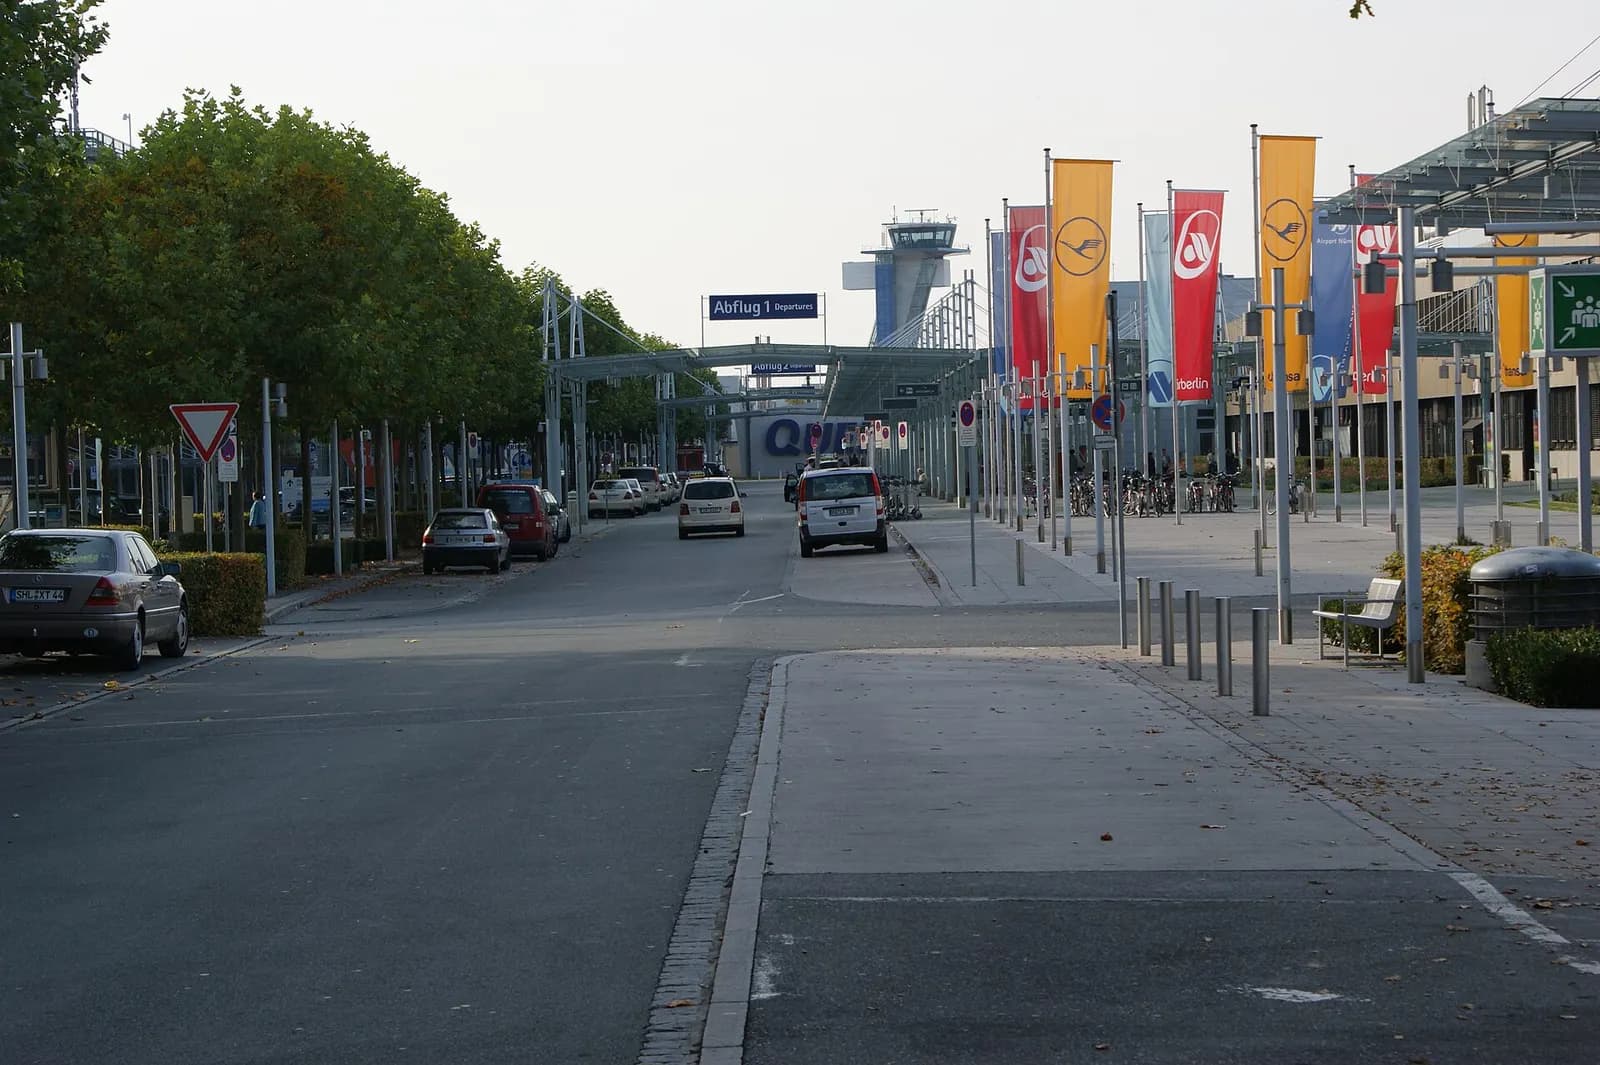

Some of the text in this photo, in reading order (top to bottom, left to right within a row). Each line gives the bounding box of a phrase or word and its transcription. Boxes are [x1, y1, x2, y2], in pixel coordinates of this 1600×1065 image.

[714, 299, 813, 317] Abflug 1 Departures
[766, 418, 859, 456] QUE
[16, 589, 33, 601] SHL
[53, 589, 65, 601] 44
